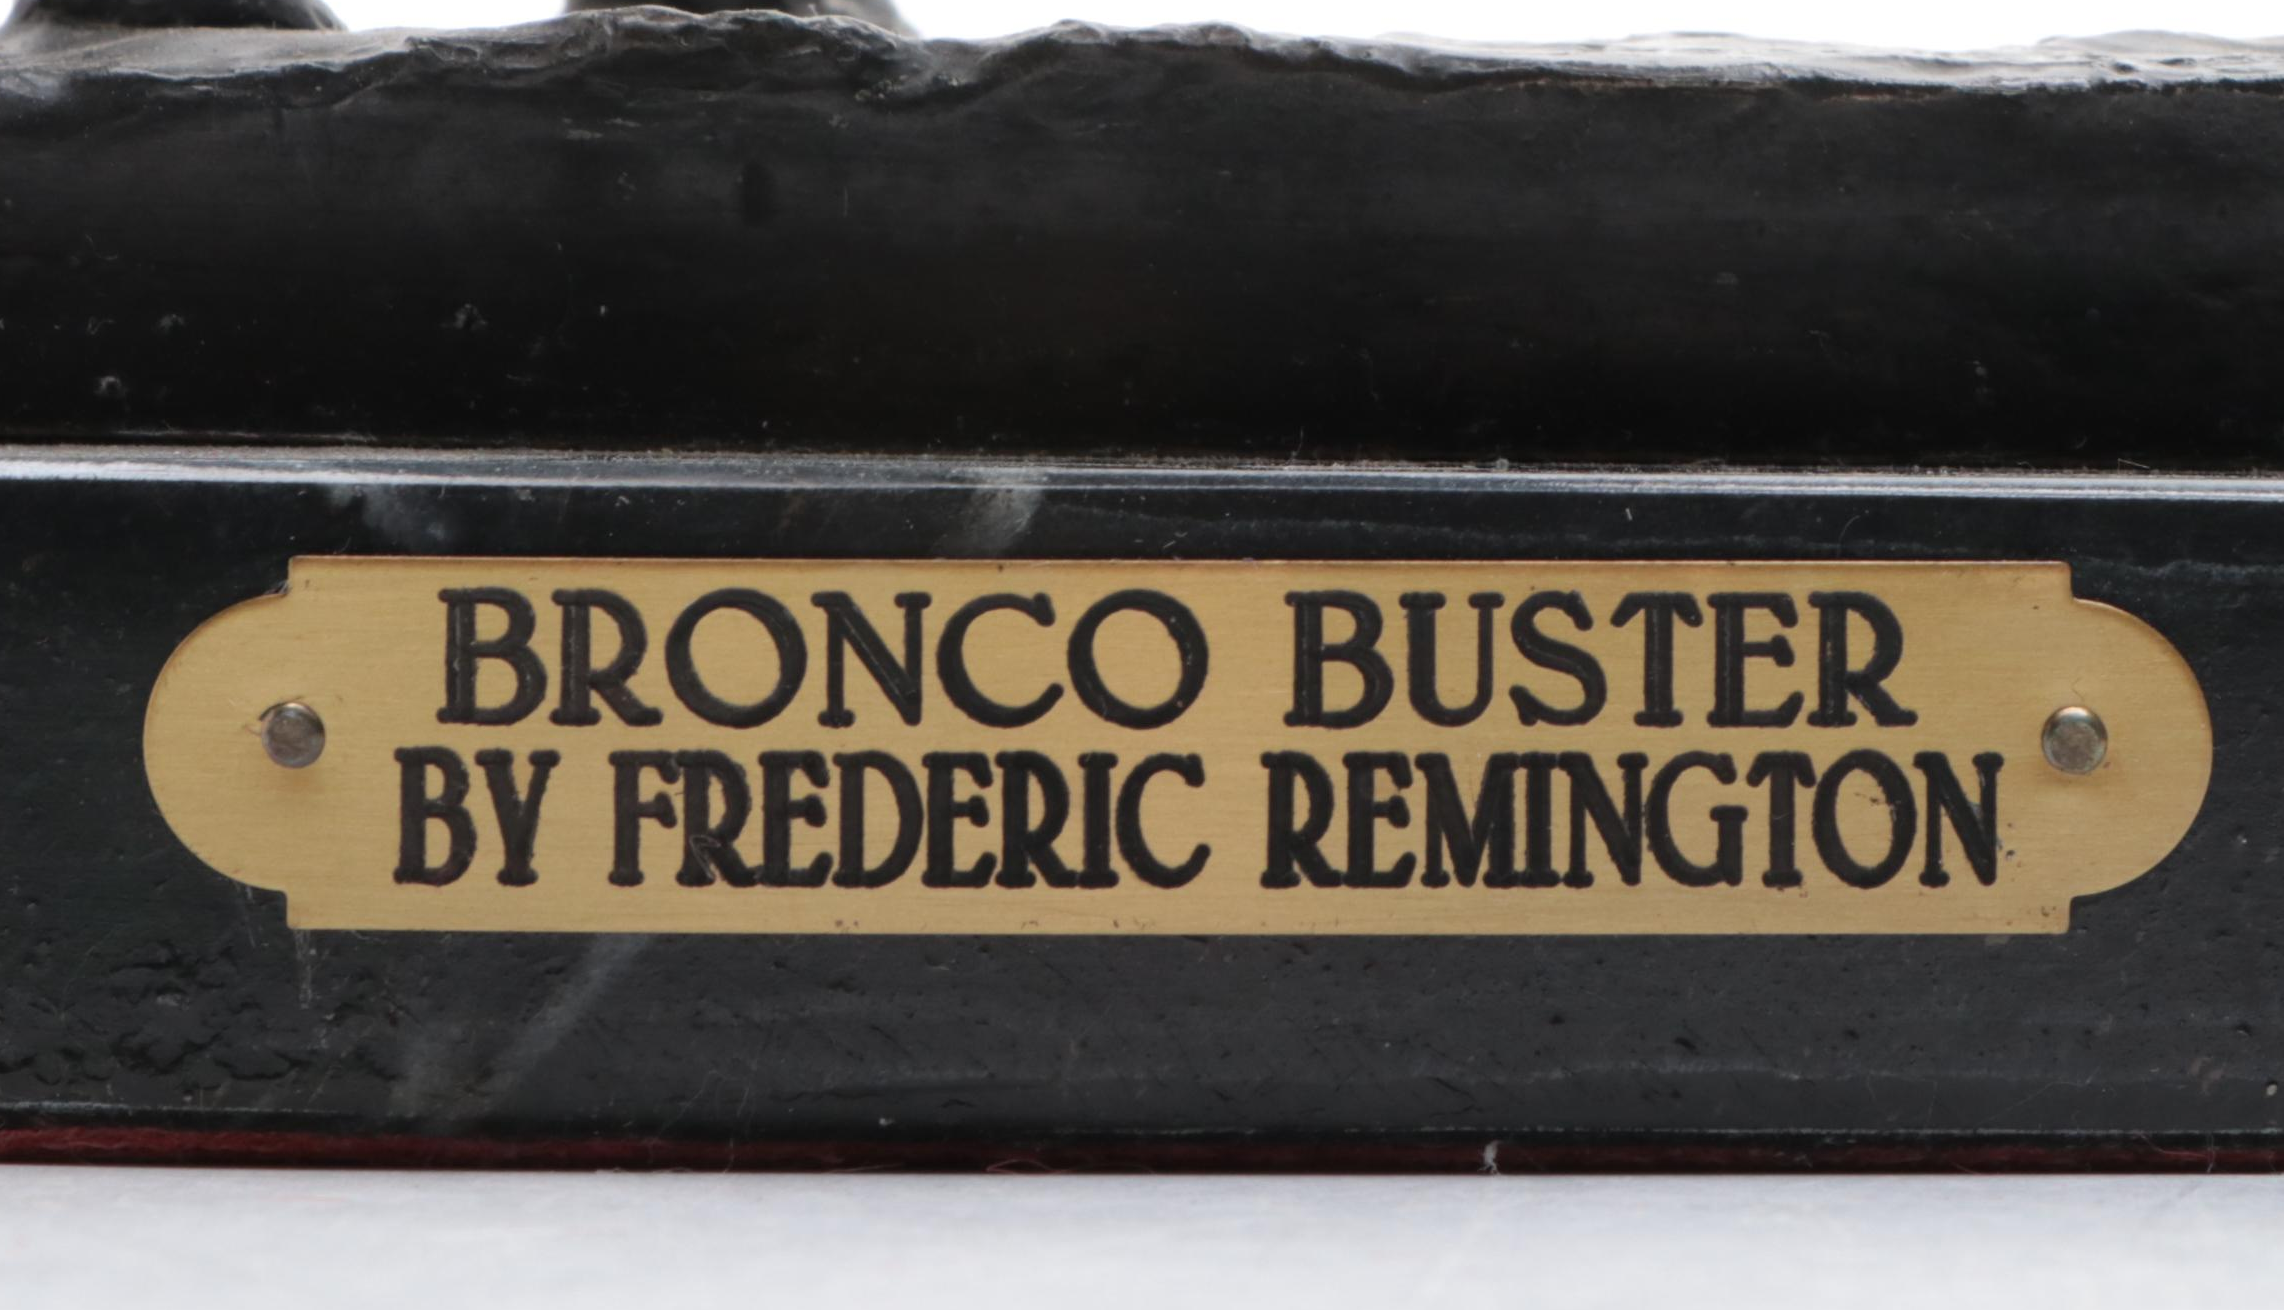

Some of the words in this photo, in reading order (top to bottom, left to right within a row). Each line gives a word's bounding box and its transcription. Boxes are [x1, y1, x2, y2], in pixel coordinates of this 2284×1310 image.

[437, 587, 1209, 729] BRONCO
[1284, 590, 1918, 729] BUSTER
[393, 746, 560, 887] BY
[608, 749, 1210, 889] FREDERIC
[1260, 749, 2004, 890] REMINGTON
